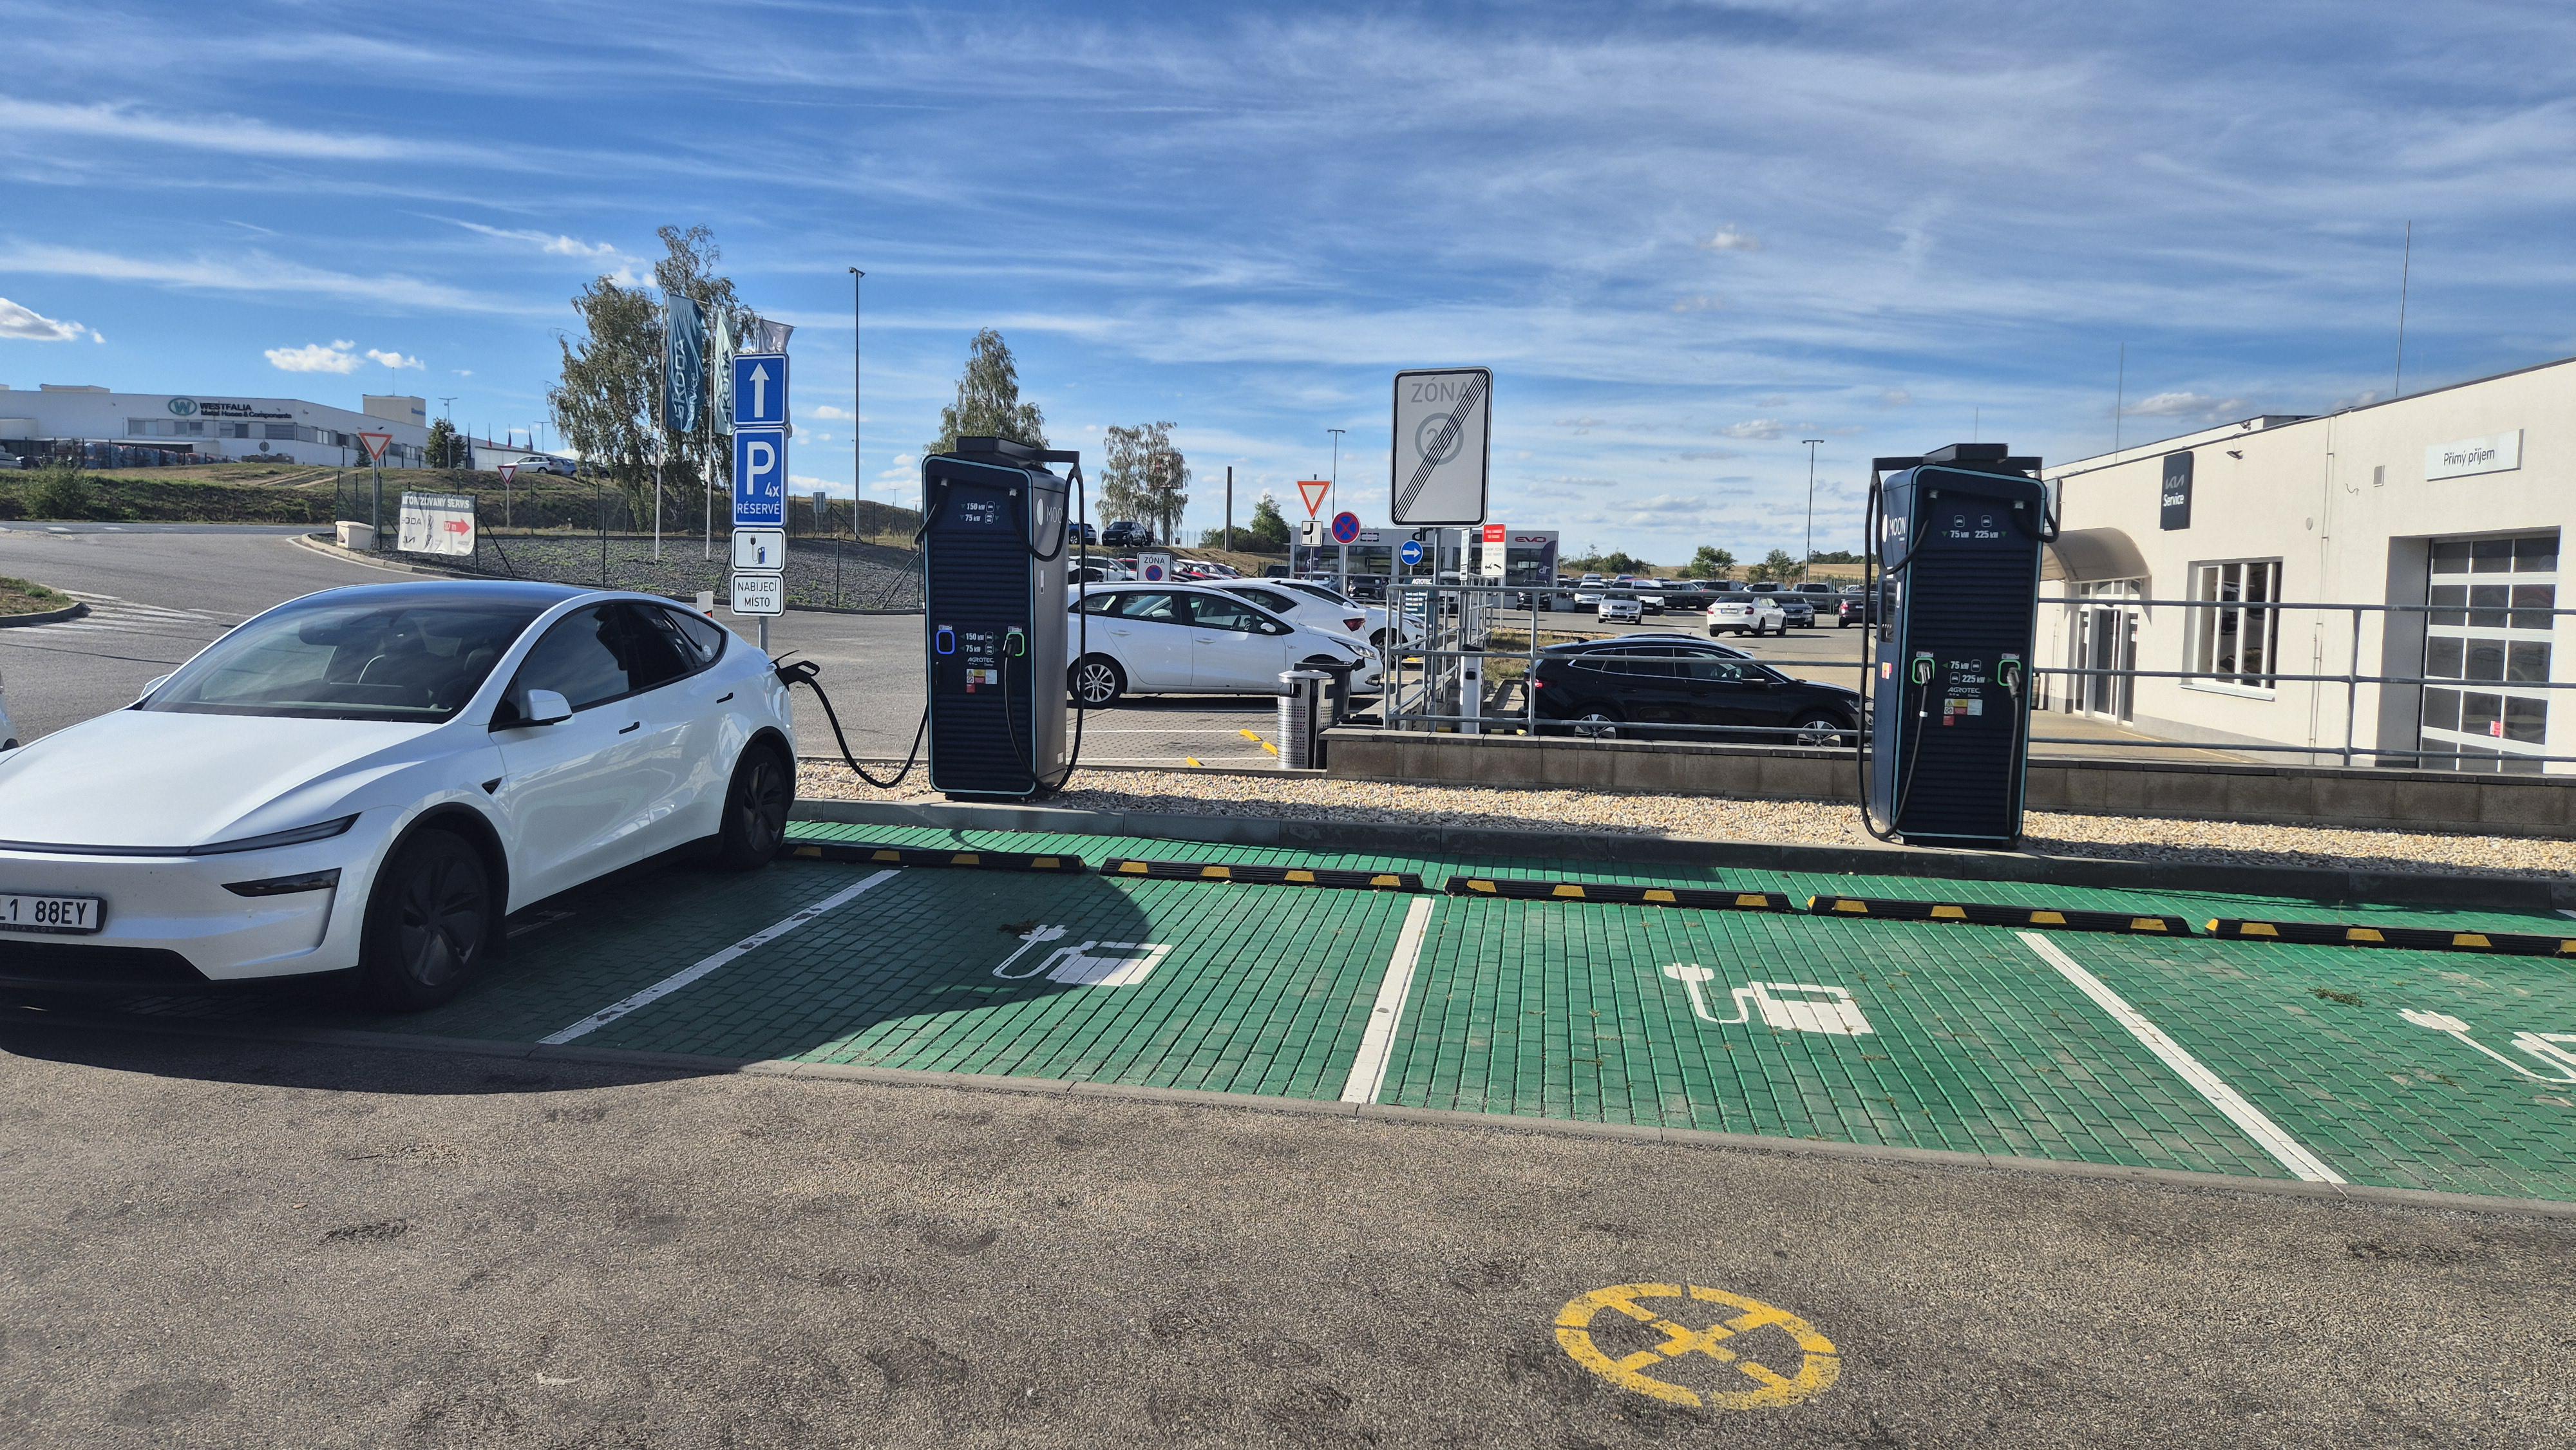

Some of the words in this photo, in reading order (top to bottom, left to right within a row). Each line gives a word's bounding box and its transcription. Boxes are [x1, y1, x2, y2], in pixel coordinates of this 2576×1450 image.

[200, 402, 252, 411] WESTFALIA
[2443, 450, 2467, 467] Přímý
[2468, 447, 2495, 466] příjem
[746, 441, 775, 494] P
[764, 482, 779, 498] 4x
[2163, 492, 2184, 507] Service
[737, 501, 780, 514] RÉSERVÉ
[967, 502, 978, 511] 150
[1144, 556, 1165, 564] ZÓNA
[738, 580, 777, 592] NABÍJECÍ
[744, 594, 770, 607] MÍSTO
[1950, 661, 1960, 670] 75
[1962, 675, 1976, 683] 225
[35, 899, 88, 925] 88EY
